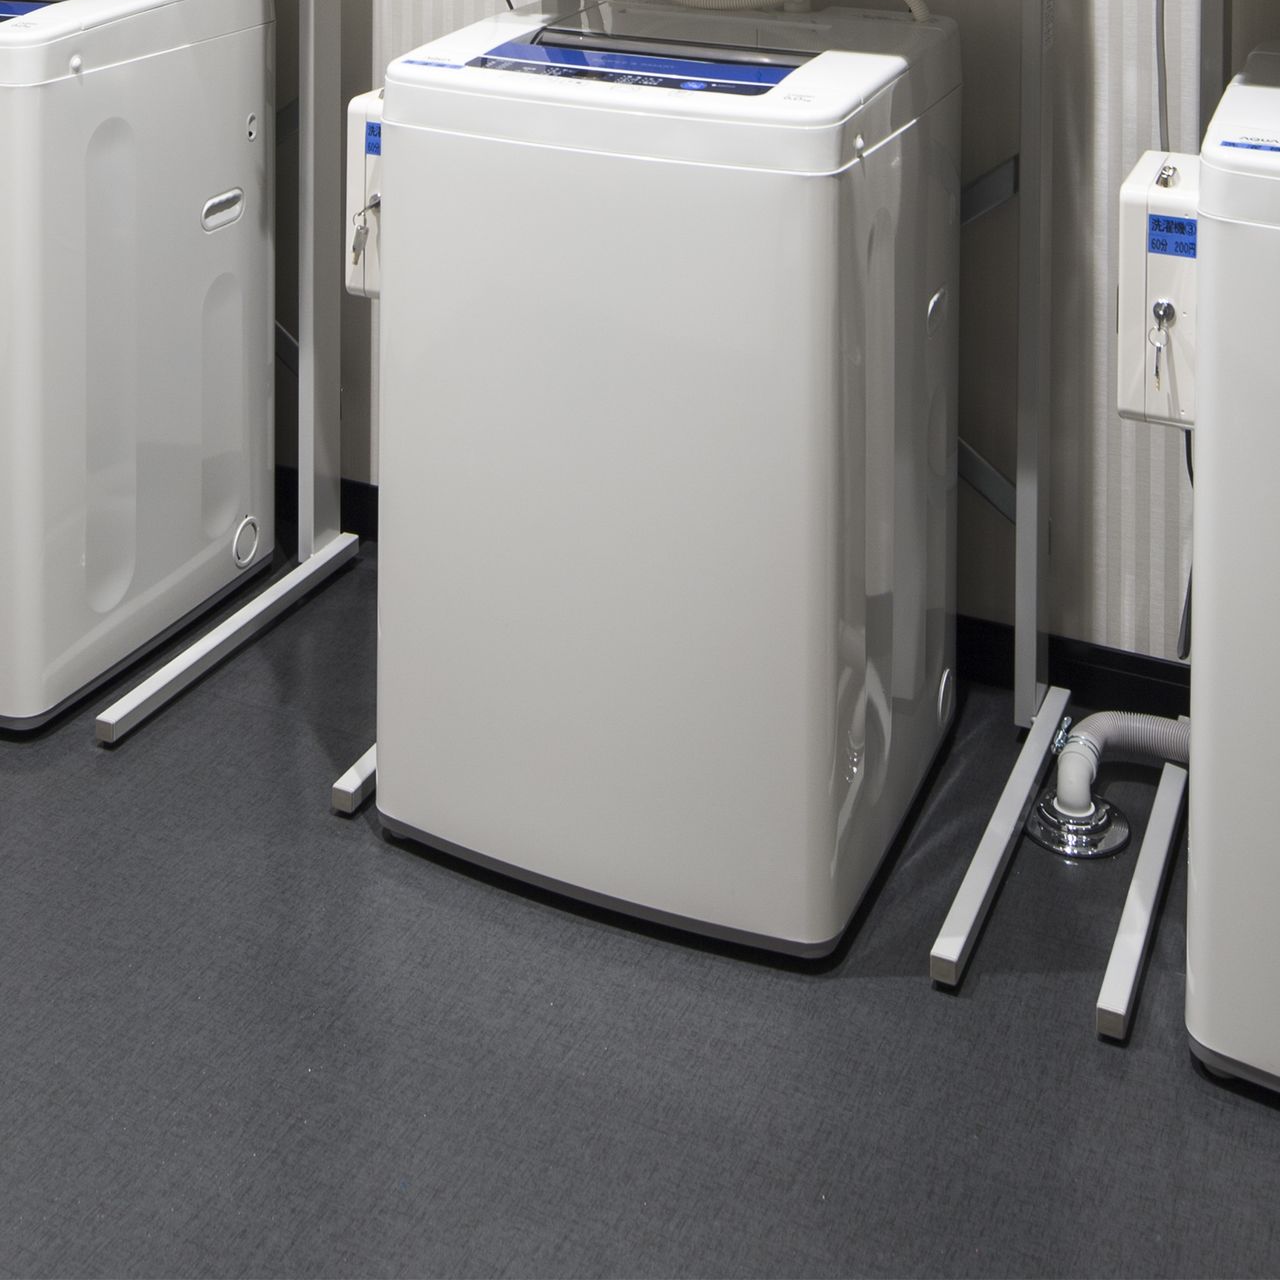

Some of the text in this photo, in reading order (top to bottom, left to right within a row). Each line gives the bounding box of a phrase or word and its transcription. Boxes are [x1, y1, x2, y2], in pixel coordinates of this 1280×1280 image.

[1152, 218, 1195, 237] 洗濯機③
[1151, 238, 1168, 252] 60分
